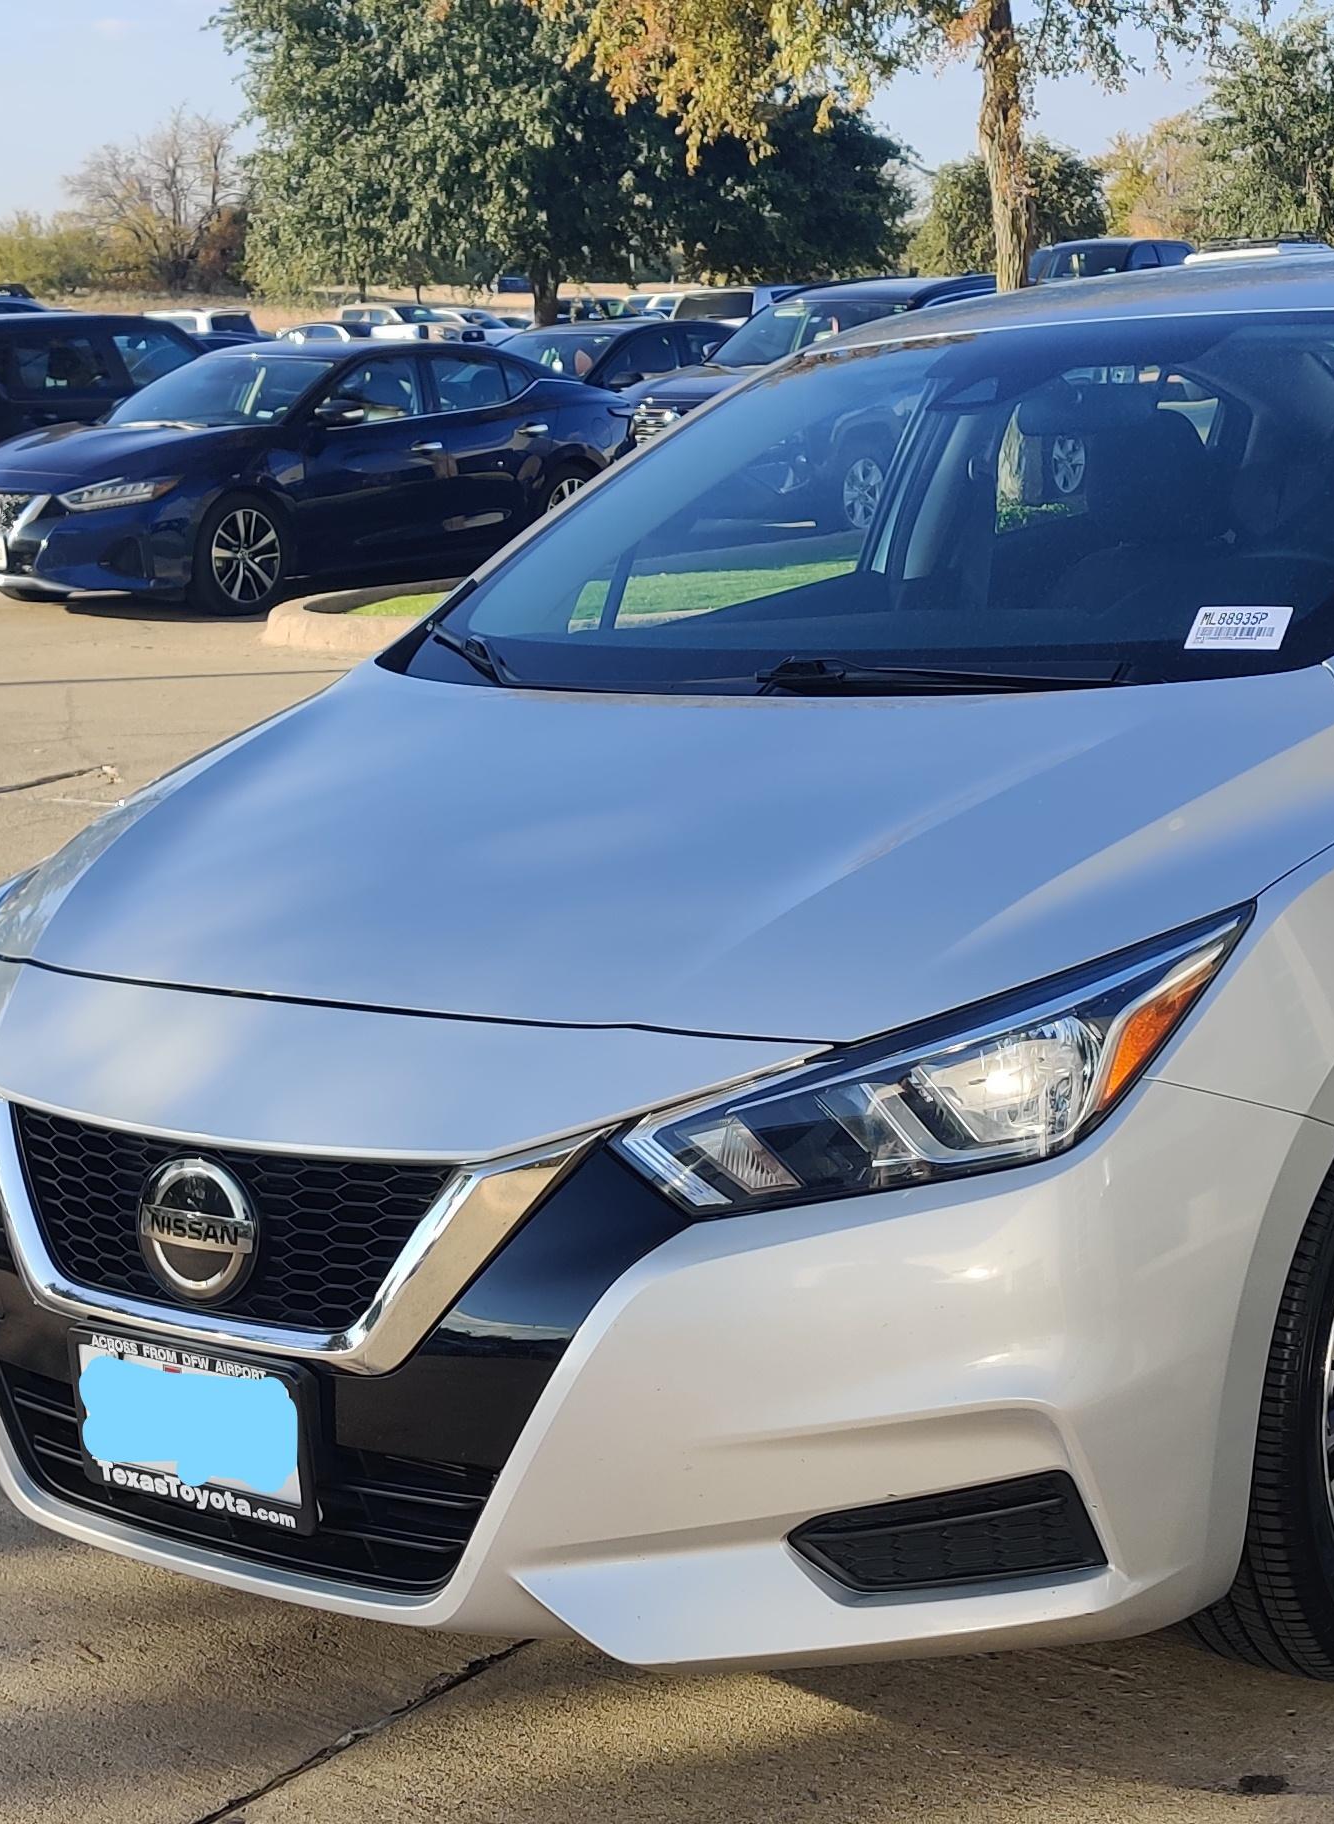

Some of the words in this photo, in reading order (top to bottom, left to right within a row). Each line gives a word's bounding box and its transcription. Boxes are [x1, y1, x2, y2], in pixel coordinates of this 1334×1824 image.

[1199, 612, 1269, 626] ML88935P
[149, 1212, 239, 1246] NISSAN
[91, 1334, 139, 1355] ACROSS
[142, 1345, 177, 1364] FROM
[181, 1353, 209, 1370] DFW
[215, 1361, 267, 1380] AIRPORT
[96, 1458, 297, 1529] TexasToyota.com
